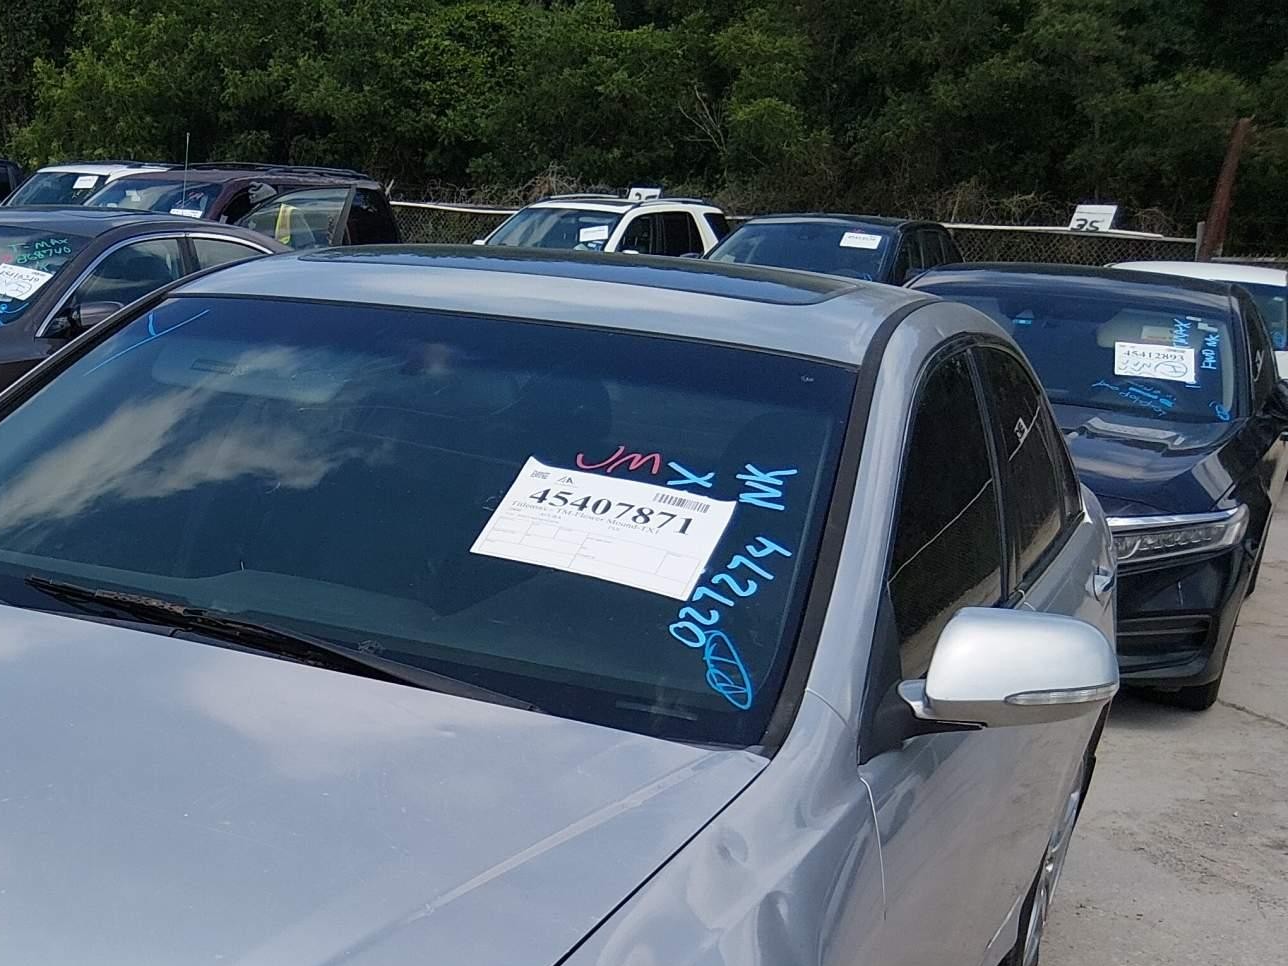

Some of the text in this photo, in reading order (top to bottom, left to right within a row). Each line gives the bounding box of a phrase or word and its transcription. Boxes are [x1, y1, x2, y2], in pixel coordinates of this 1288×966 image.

[1123, 350, 1185, 361] 45412893
[736, 463, 798, 511] NK
[529, 487, 695, 536] 45407871
[669, 536, 793, 648] 027274
